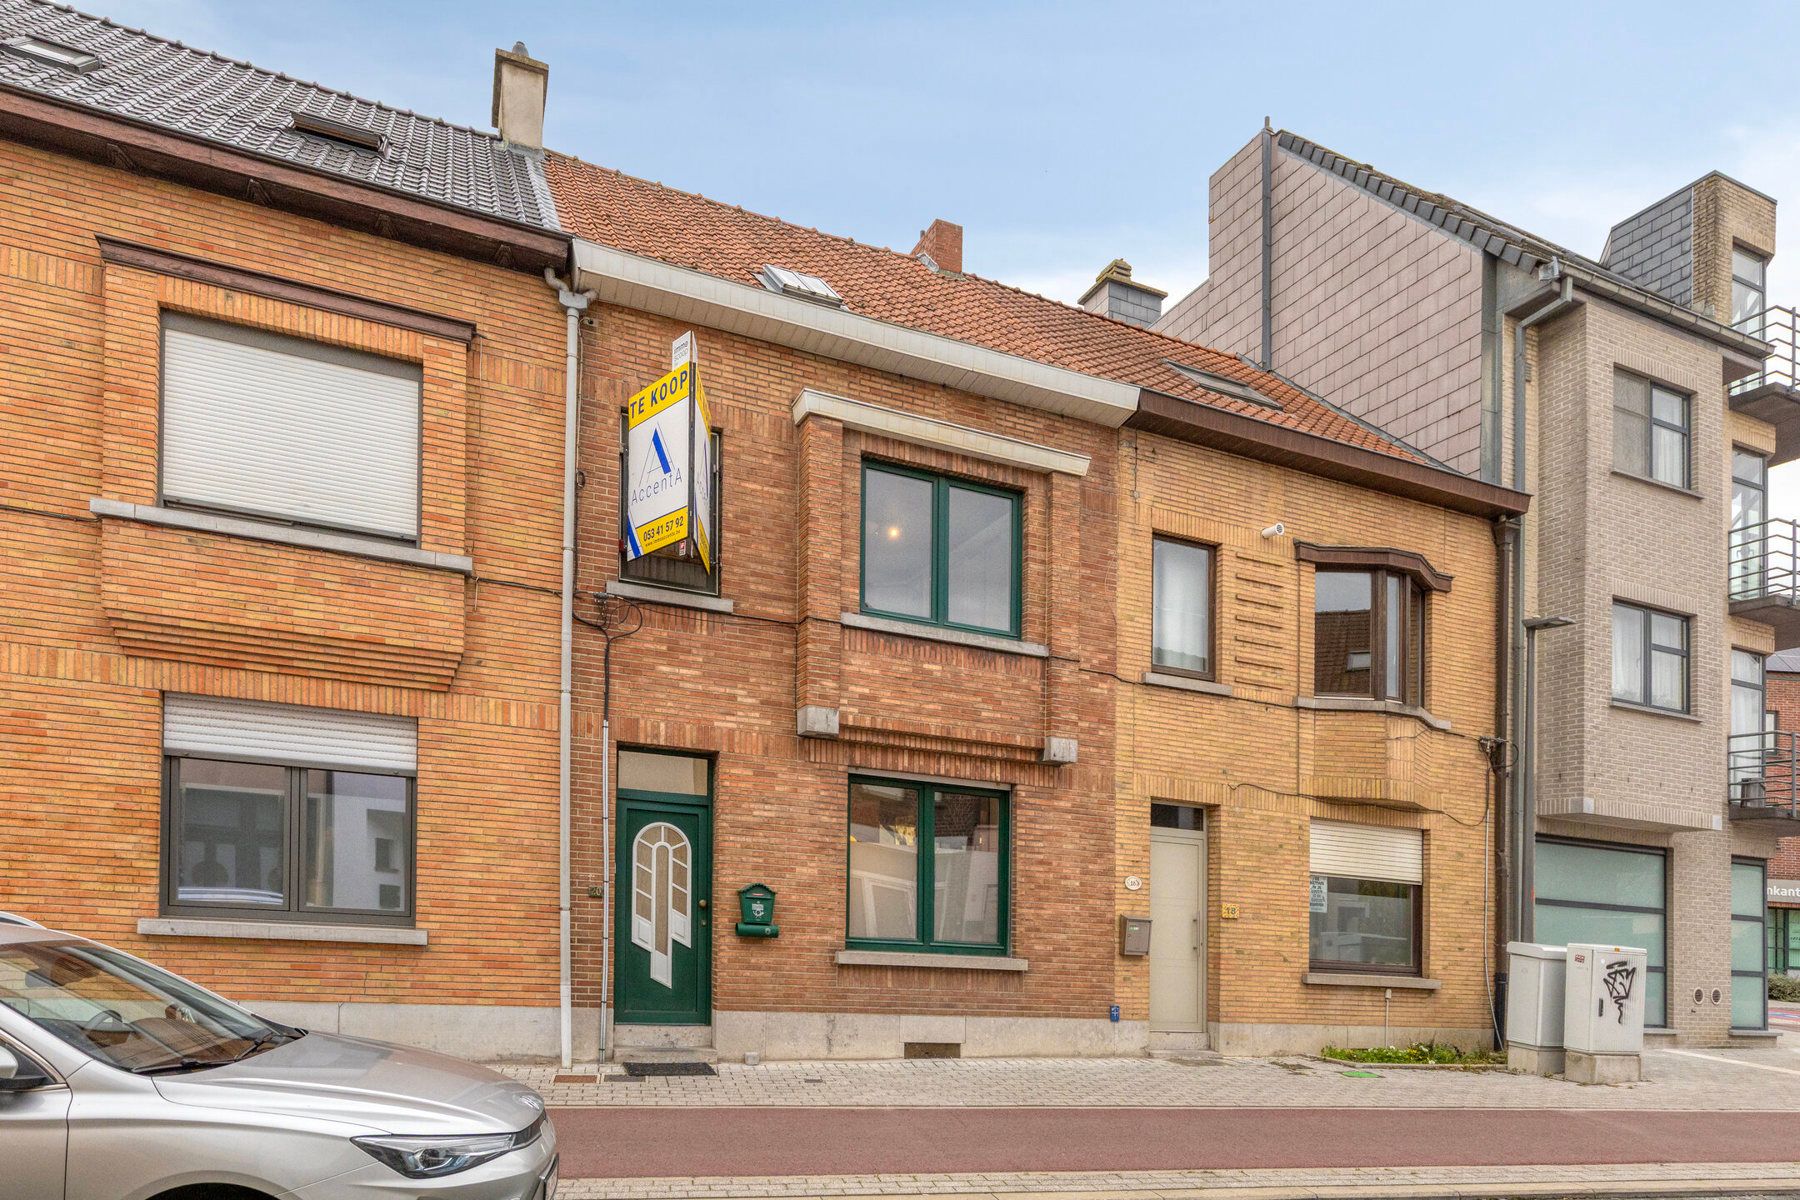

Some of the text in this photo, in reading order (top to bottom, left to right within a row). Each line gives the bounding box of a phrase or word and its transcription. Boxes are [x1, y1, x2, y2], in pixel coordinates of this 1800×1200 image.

[630, 396, 645, 419] TE
[650, 370, 688, 408] KOOP
[632, 468, 682, 505] AccentA
[644, 516, 684, 541] 053 41 57 92
[591, 886, 602, 896] 20
